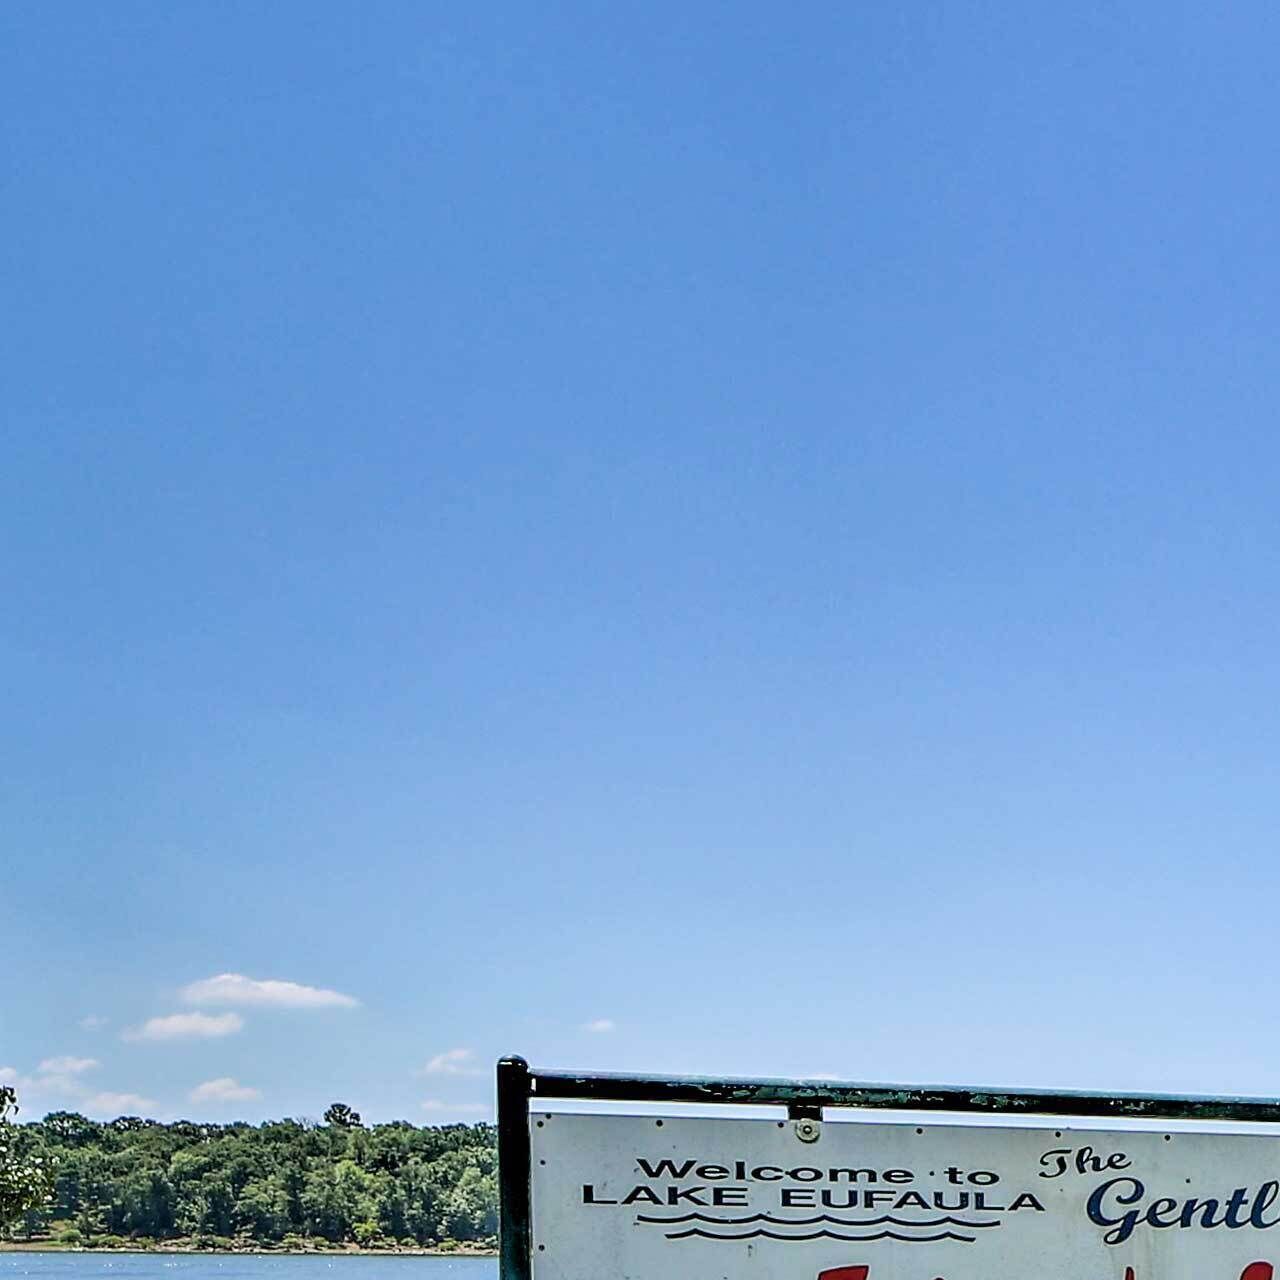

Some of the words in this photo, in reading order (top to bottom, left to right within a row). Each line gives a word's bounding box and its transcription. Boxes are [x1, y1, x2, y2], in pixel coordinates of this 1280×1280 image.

[636, 1158, 914, 1184] Welcome
[943, 1166, 1000, 1185] to
[1038, 1146, 1132, 1179] The
[582, 1184, 749, 1207] LAKE
[780, 1187, 1046, 1212] EUFAULA
